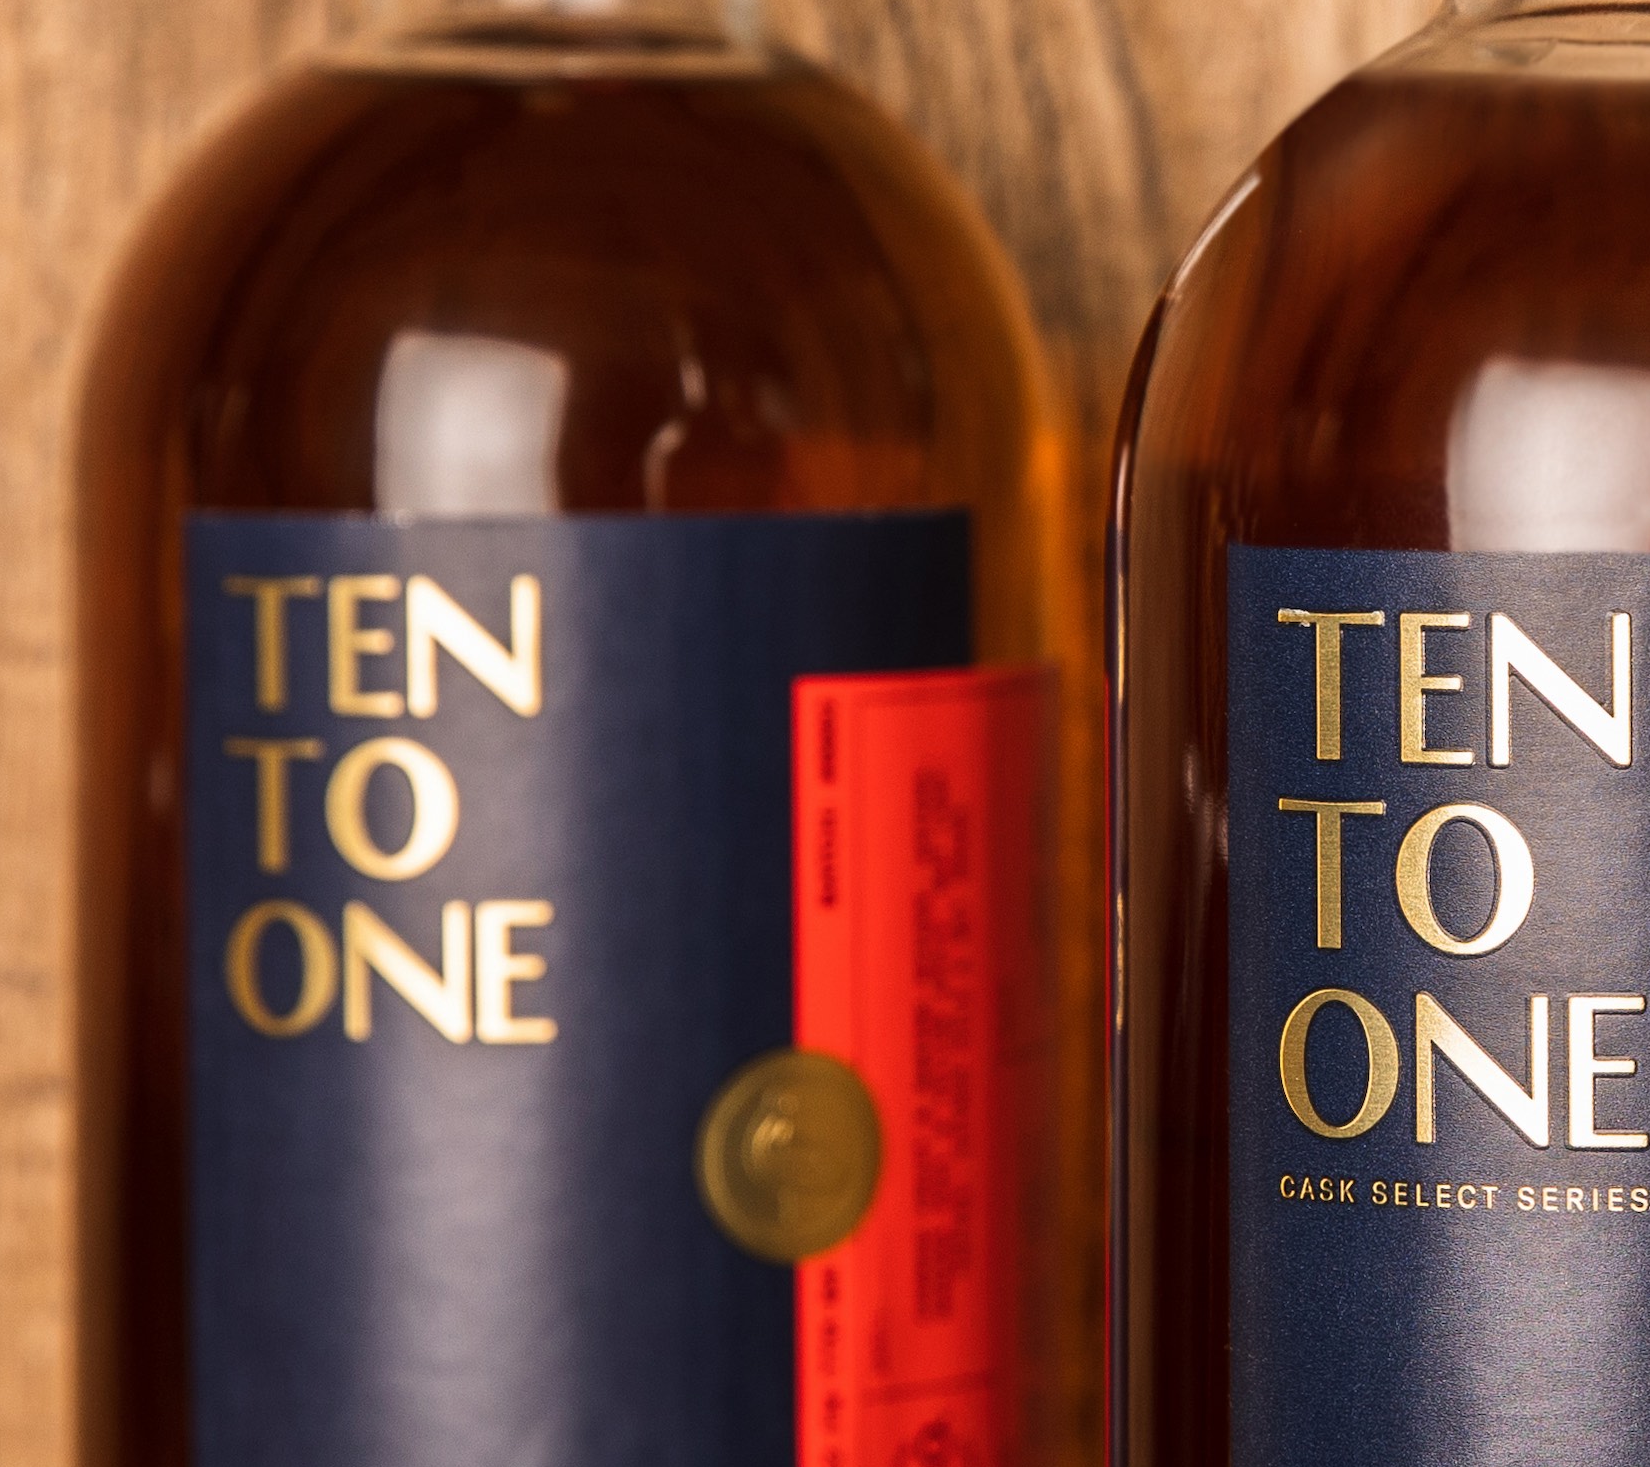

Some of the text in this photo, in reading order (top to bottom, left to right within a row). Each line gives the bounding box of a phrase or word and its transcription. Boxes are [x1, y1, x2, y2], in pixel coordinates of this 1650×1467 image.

[222, 573, 543, 718] TEN
[1277, 608, 1632, 768] TEN
[224, 735, 461, 882] TO
[1278, 798, 1535, 957] TO
[224, 898, 559, 1045] ONE
[1279, 988, 1650, 1150] ONE
[1280, 1175, 1650, 1213] CASK SELECT SERIES
